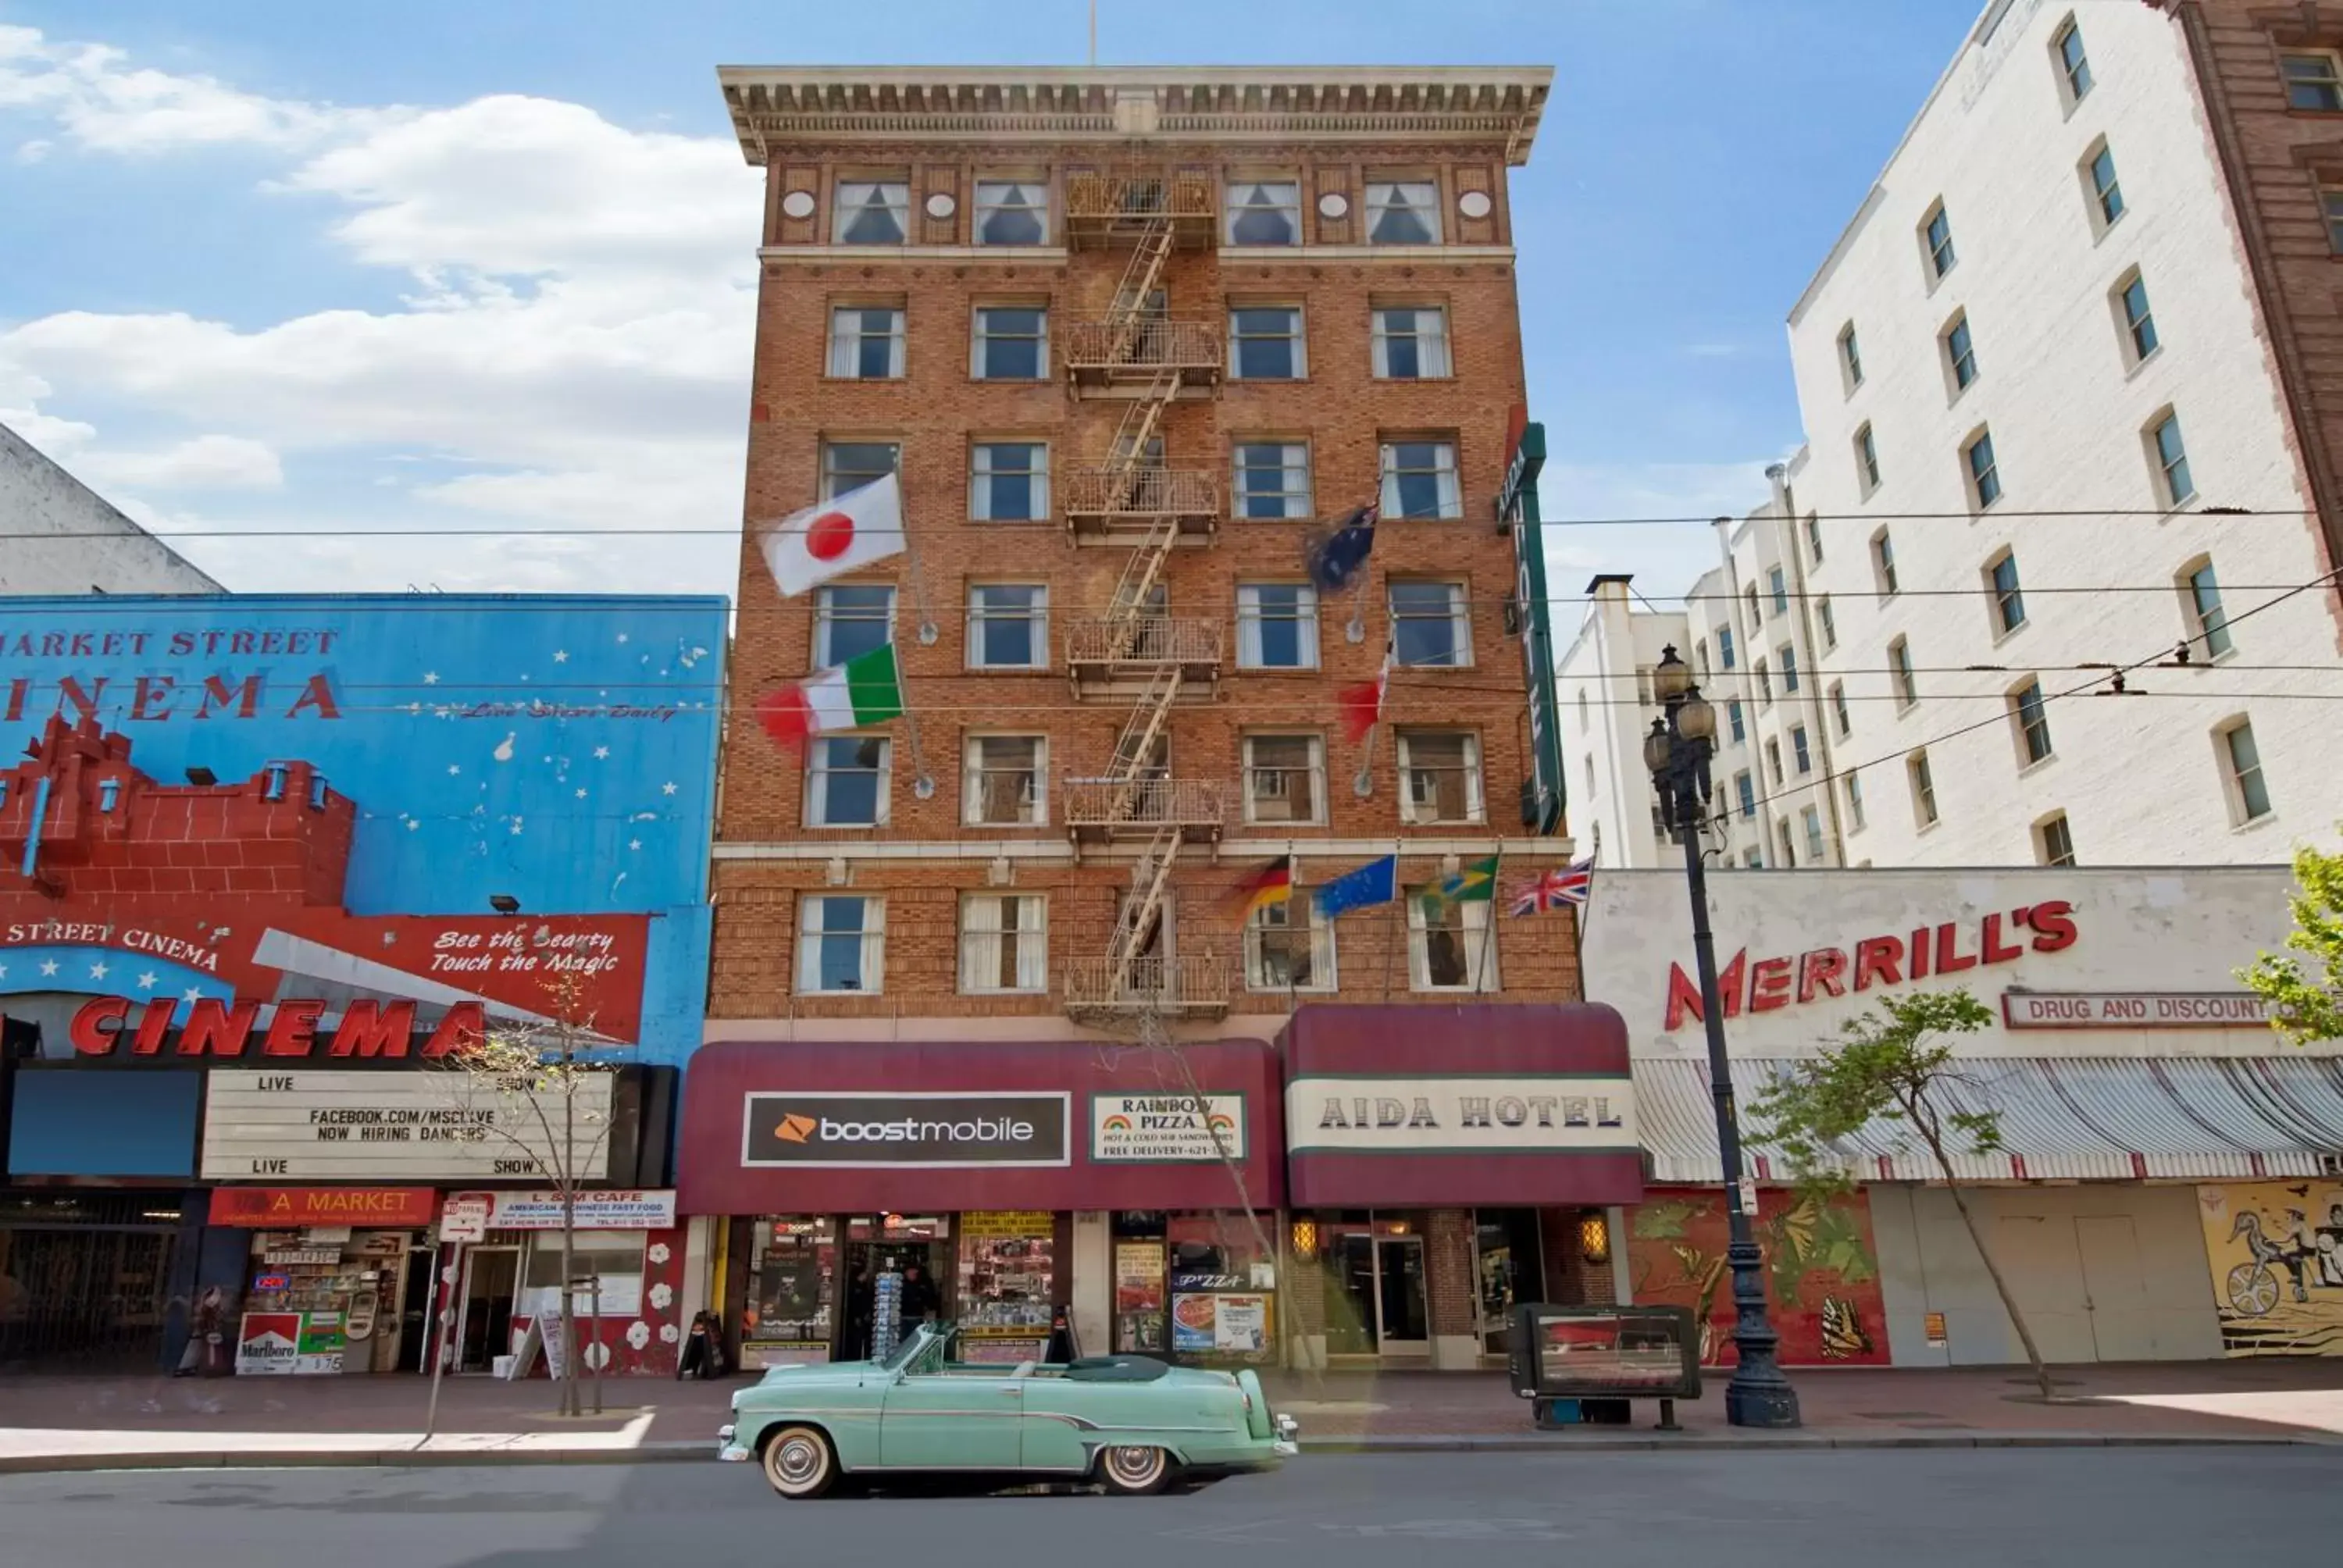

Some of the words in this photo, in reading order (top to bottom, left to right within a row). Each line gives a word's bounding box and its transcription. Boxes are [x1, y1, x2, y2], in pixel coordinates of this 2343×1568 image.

[169, 629, 339, 657] STREET
[6, 923, 115, 942] STREET
[122, 928, 219, 971] CINEMA
[433, 931, 482, 949] See
[488, 931, 525, 948] the
[430, 953, 492, 971] Touch
[499, 953, 537, 971] the
[544, 953, 619, 975] Magic
[1664, 900, 2078, 1031] MERRILL'S
[2029, 1000, 2092, 1019] DRUG
[2102, 1000, 2147, 1018] AND
[2157, 999, 2267, 1018] DISCOUNT
[70, 997, 486, 1058] CINEMA
[259, 1077, 294, 1091] LIVE
[1122, 1099, 1214, 1113] RAINBOW
[1319, 1096, 1440, 1129] AIDA
[1459, 1095, 1624, 1128] HOTEL
[1141, 1115, 1196, 1129] PIZZA
[318, 1127, 349, 1141] NOW
[361, 1127, 411, 1141] HIRING
[1103, 1134, 1123, 1142] HOT
[1104, 1146, 1128, 1156] FREE
[252, 1160, 287, 1174] LIVE
[494, 1160, 534, 1174] SHOW
[307, 1192, 413, 1211] MARKET
[593, 1192, 644, 1202] CAFE
[241, 1340, 294, 1358] Marlboro
